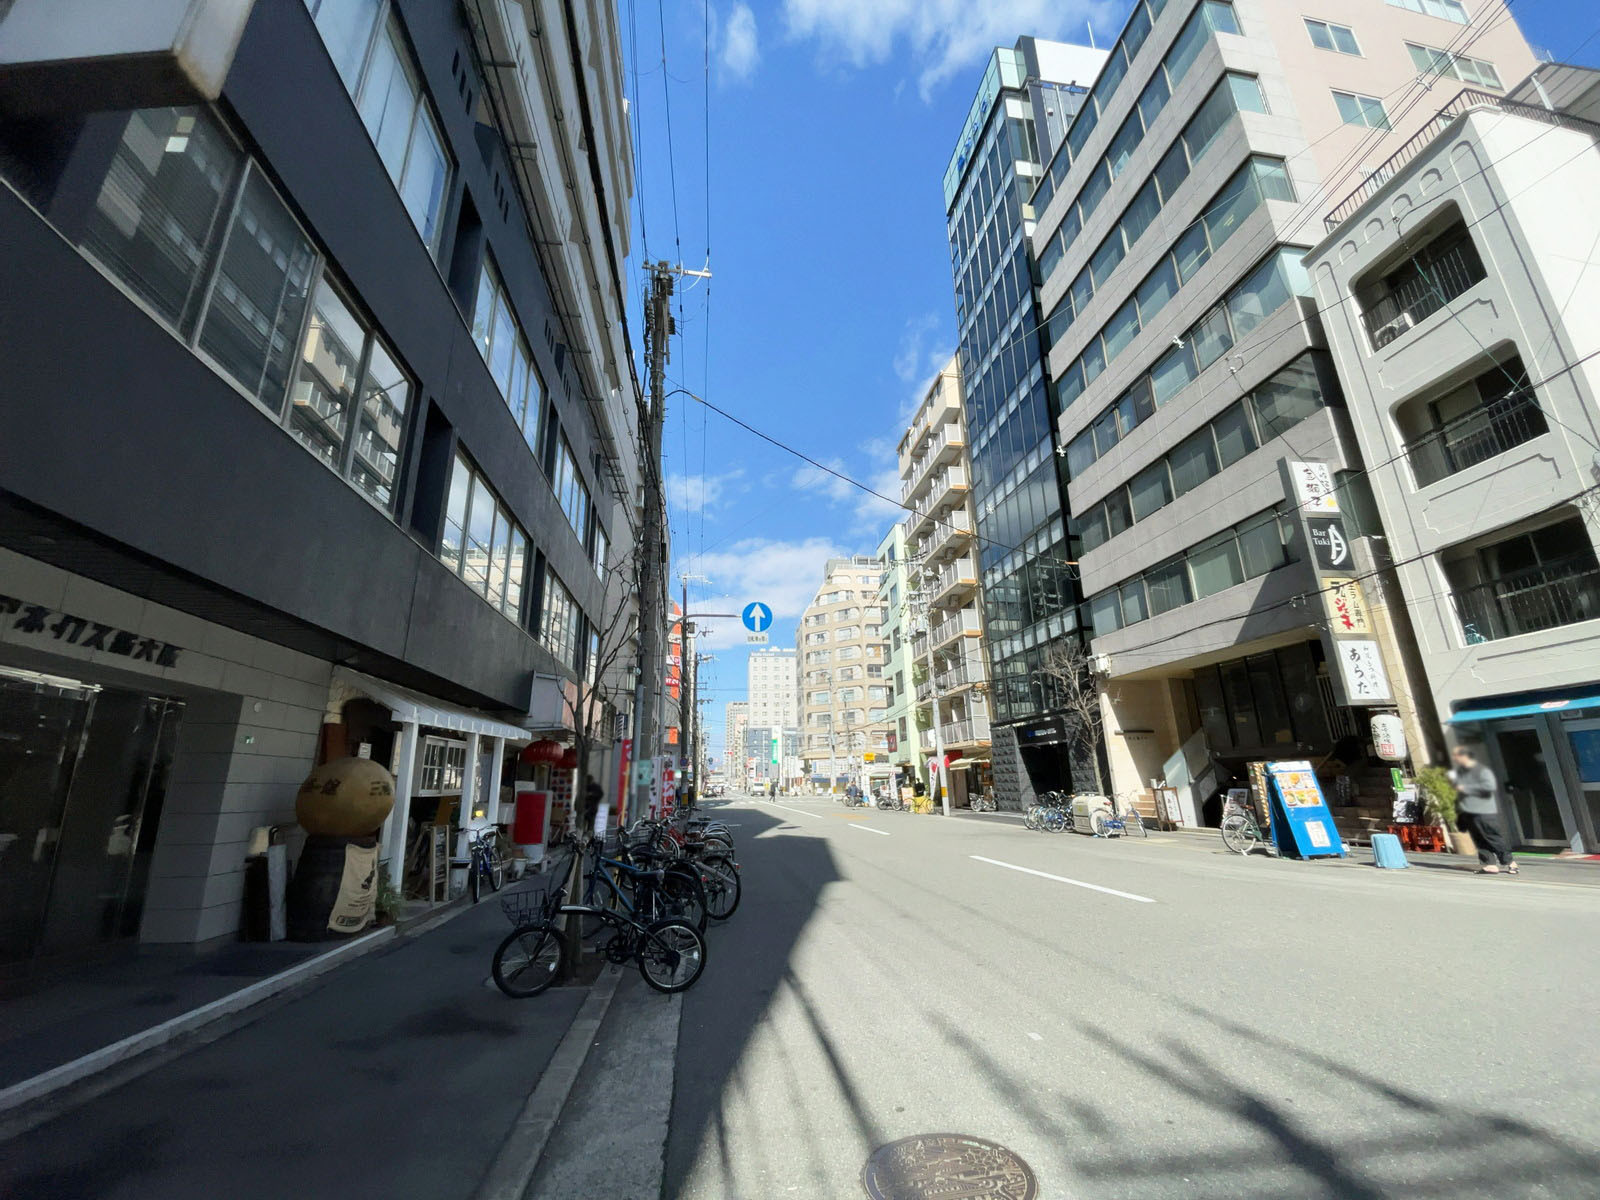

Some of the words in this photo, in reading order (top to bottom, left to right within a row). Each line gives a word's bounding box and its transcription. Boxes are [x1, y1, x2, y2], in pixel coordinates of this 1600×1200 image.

[1312, 528, 1326, 537] Bar
[1312, 537, 1331, 546] Tuki
[1349, 648, 1371, 695] あらた
